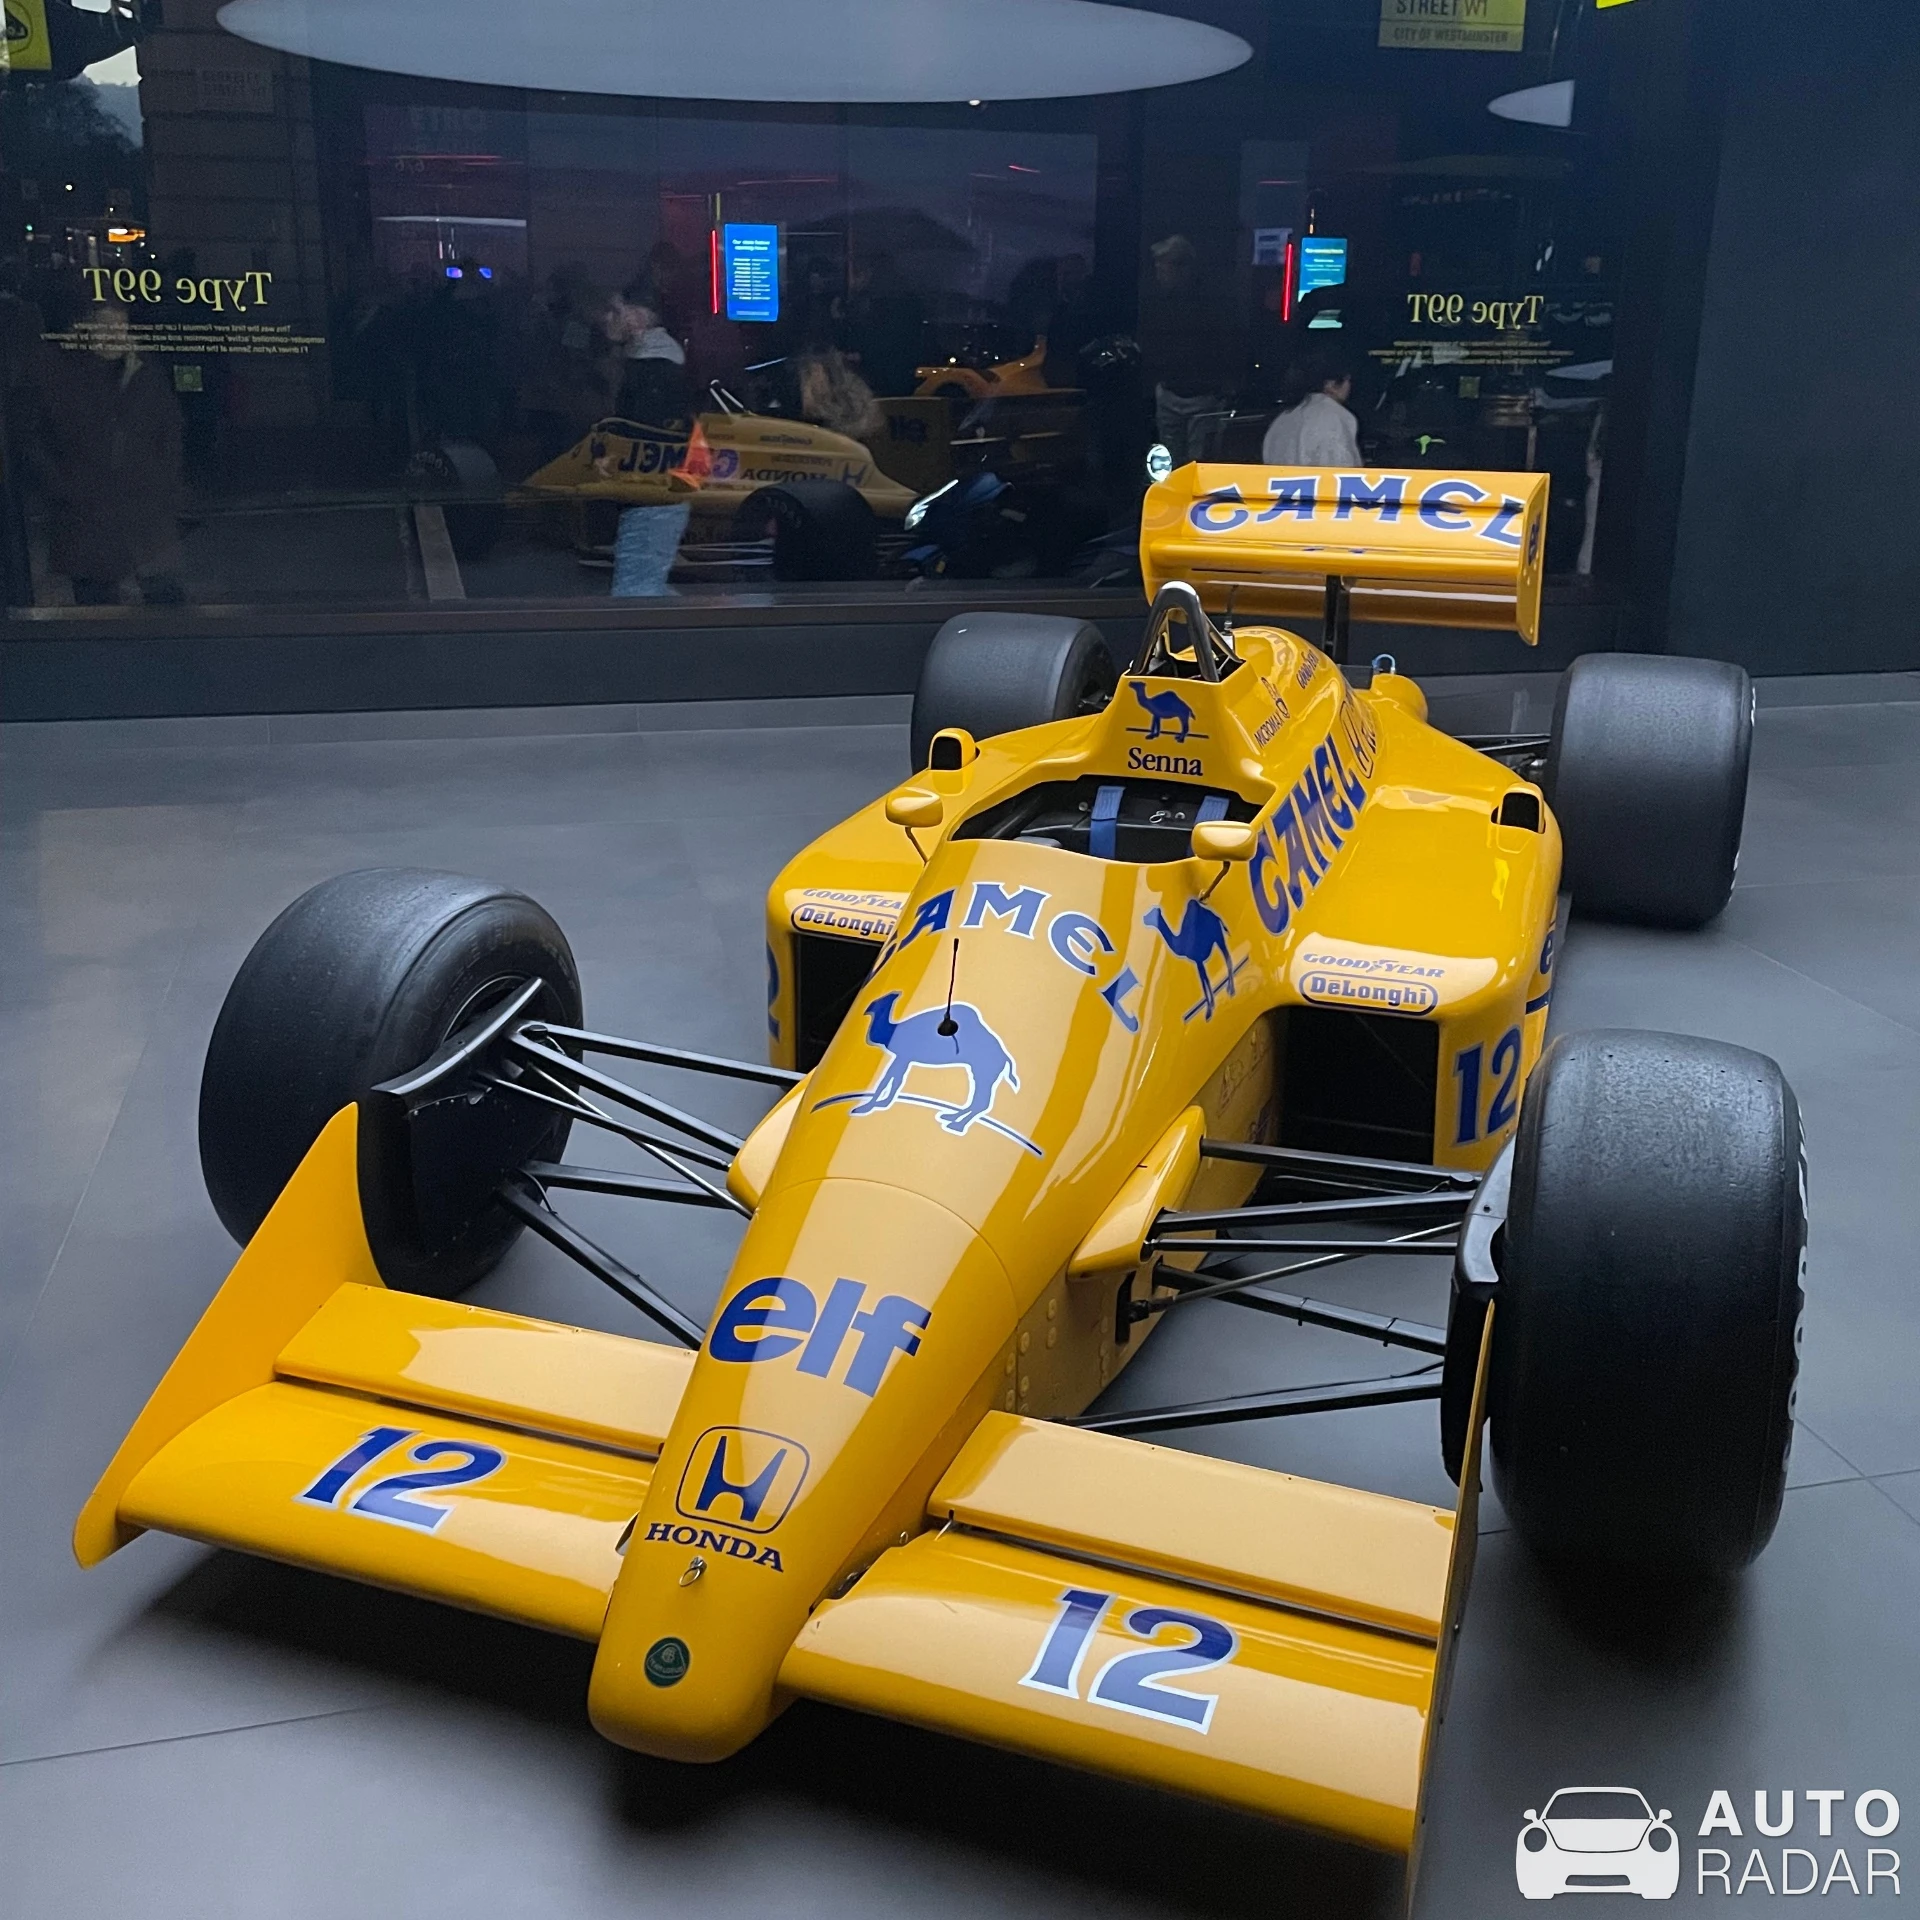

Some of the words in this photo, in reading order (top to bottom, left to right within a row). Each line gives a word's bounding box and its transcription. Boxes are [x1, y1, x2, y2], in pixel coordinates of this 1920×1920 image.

[1397, 0, 1458, 15] STREET
[1188, 473, 1525, 548] CAMEL
[1128, 747, 1203, 776] Senna
[1249, 733, 1368, 937] CAMEL
[802, 888, 903, 910] GOODYEA
[1303, 953, 1445, 978] GOODYEAR
[1454, 1024, 1522, 1145] 12
[709, 1277, 932, 1398] elf
[294, 1427, 507, 1534] 12
[645, 1523, 784, 1573] HONDA
[1018, 1588, 1240, 1735] 12
